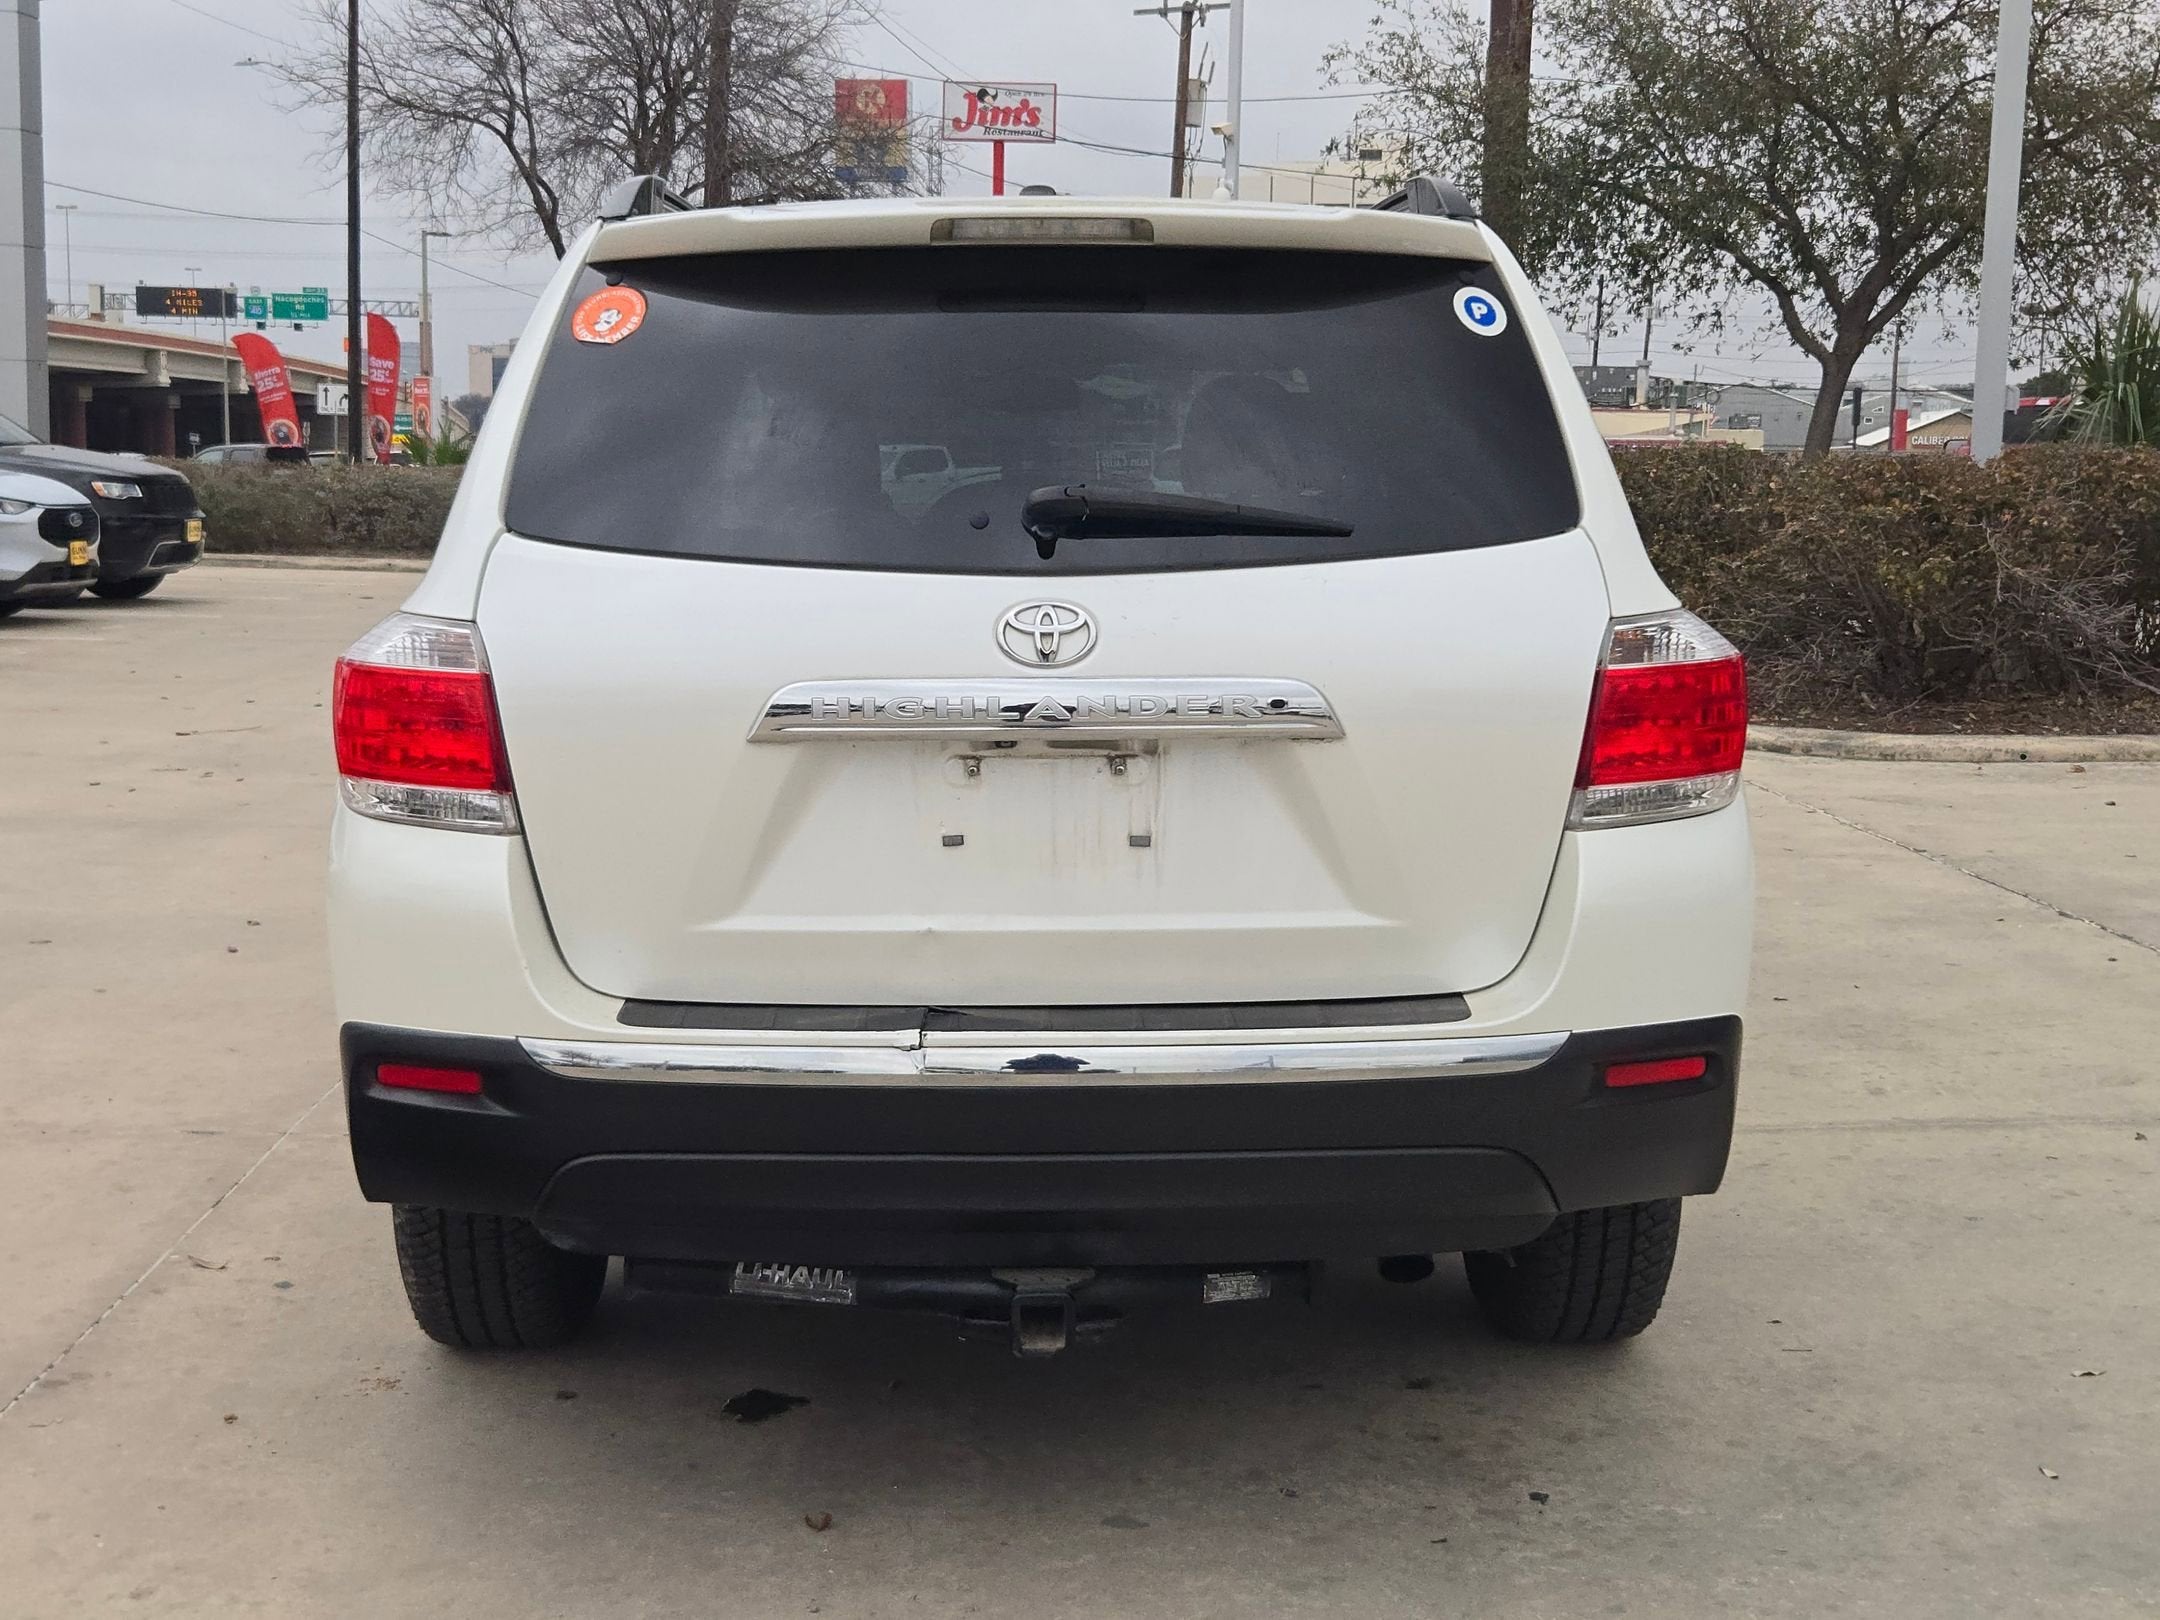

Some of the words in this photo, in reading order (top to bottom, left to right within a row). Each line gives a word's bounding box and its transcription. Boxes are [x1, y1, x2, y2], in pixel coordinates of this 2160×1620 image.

[952, 92, 1042, 132] Jim's
[983, 126, 1043, 138] Restaurant
[176, 299, 204, 307] MILES
[171, 307, 177, 315] 4
[1470, 302, 1488, 320] P
[370, 356, 394, 370] Save
[1911, 435, 1950, 445] CALIBER
[811, 694, 1262, 721] HIGHLANDER
